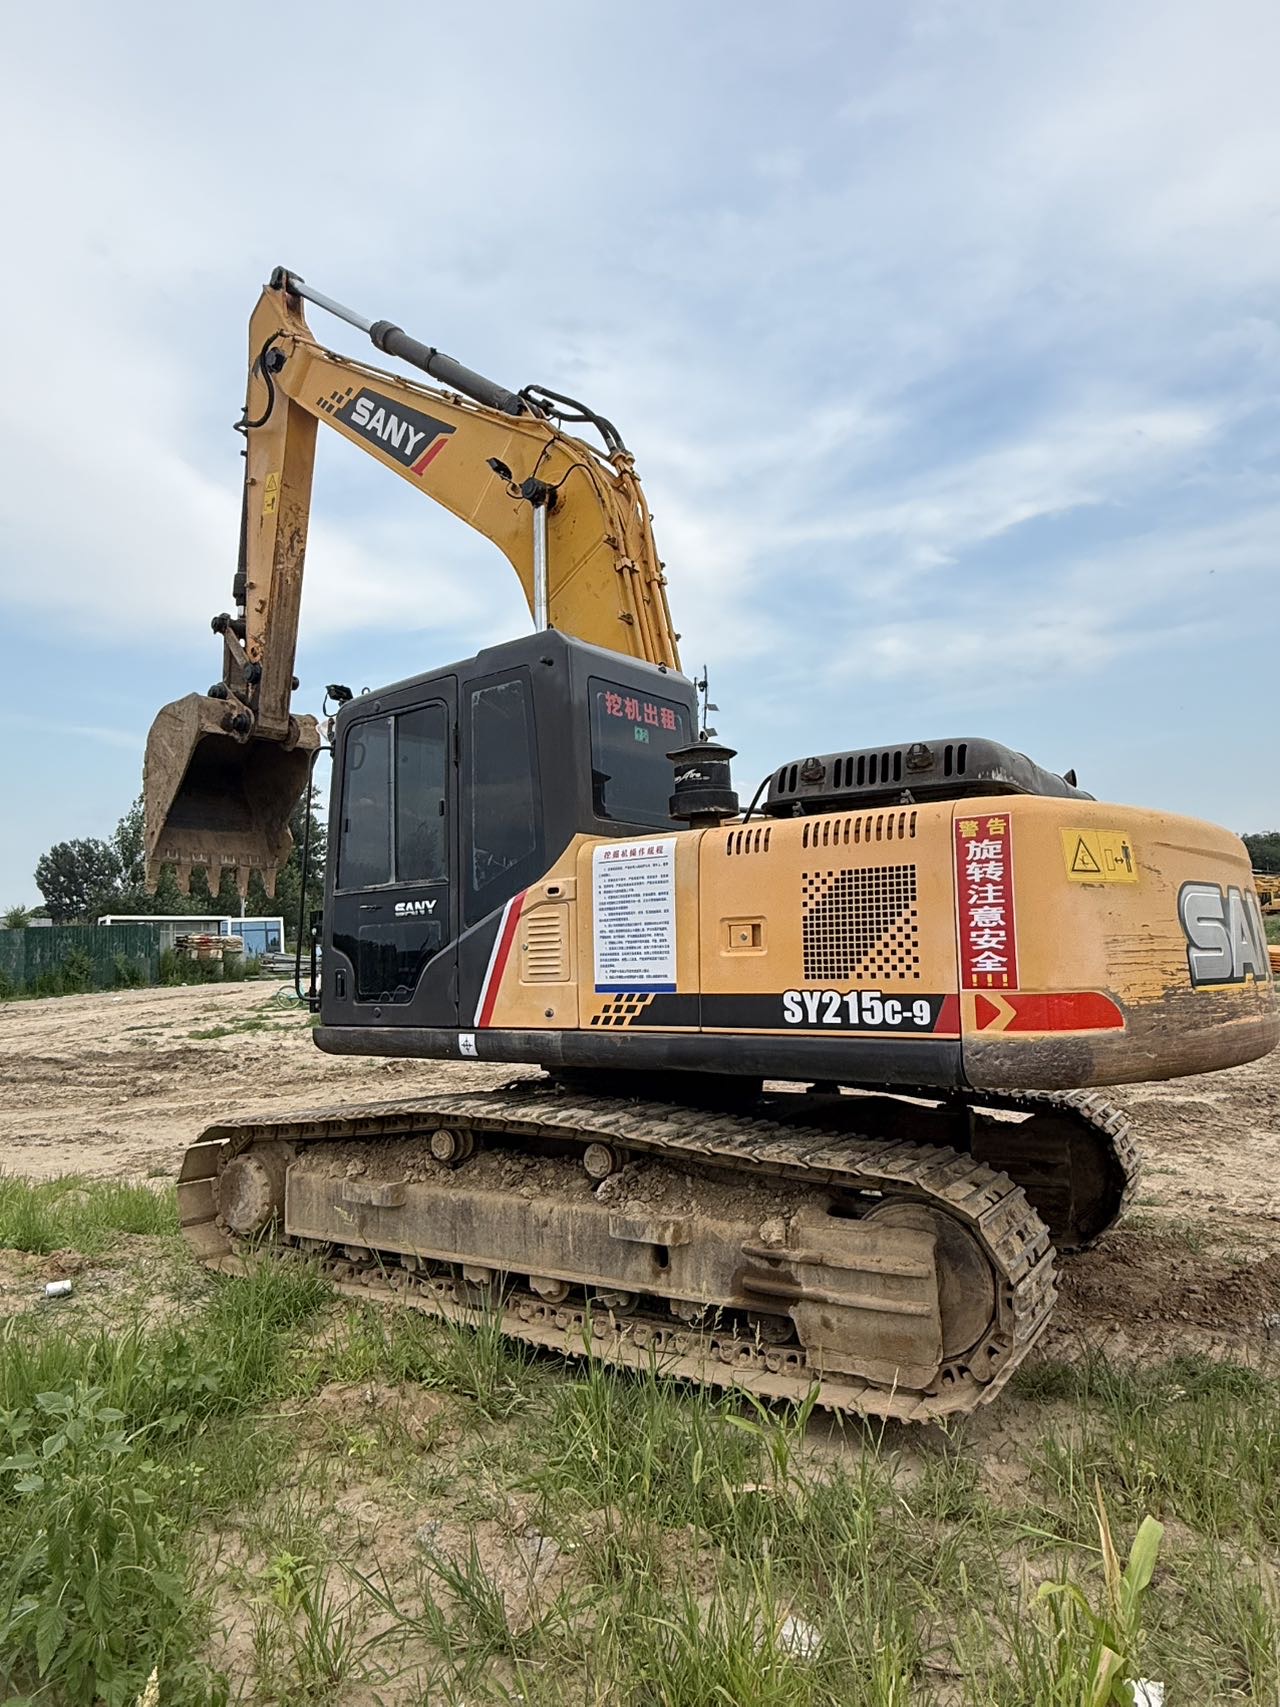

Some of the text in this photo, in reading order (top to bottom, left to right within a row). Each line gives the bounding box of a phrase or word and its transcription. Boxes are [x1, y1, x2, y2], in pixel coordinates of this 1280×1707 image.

[351, 396, 426, 456] SANY
[605, 691, 677, 731] 挖机出租
[959, 817, 1007, 838] 警告
[394, 899, 437, 918] SANY
[965, 838, 1009, 973] 旋转注意安全
[782, 990, 932, 1026] SY215C-9
